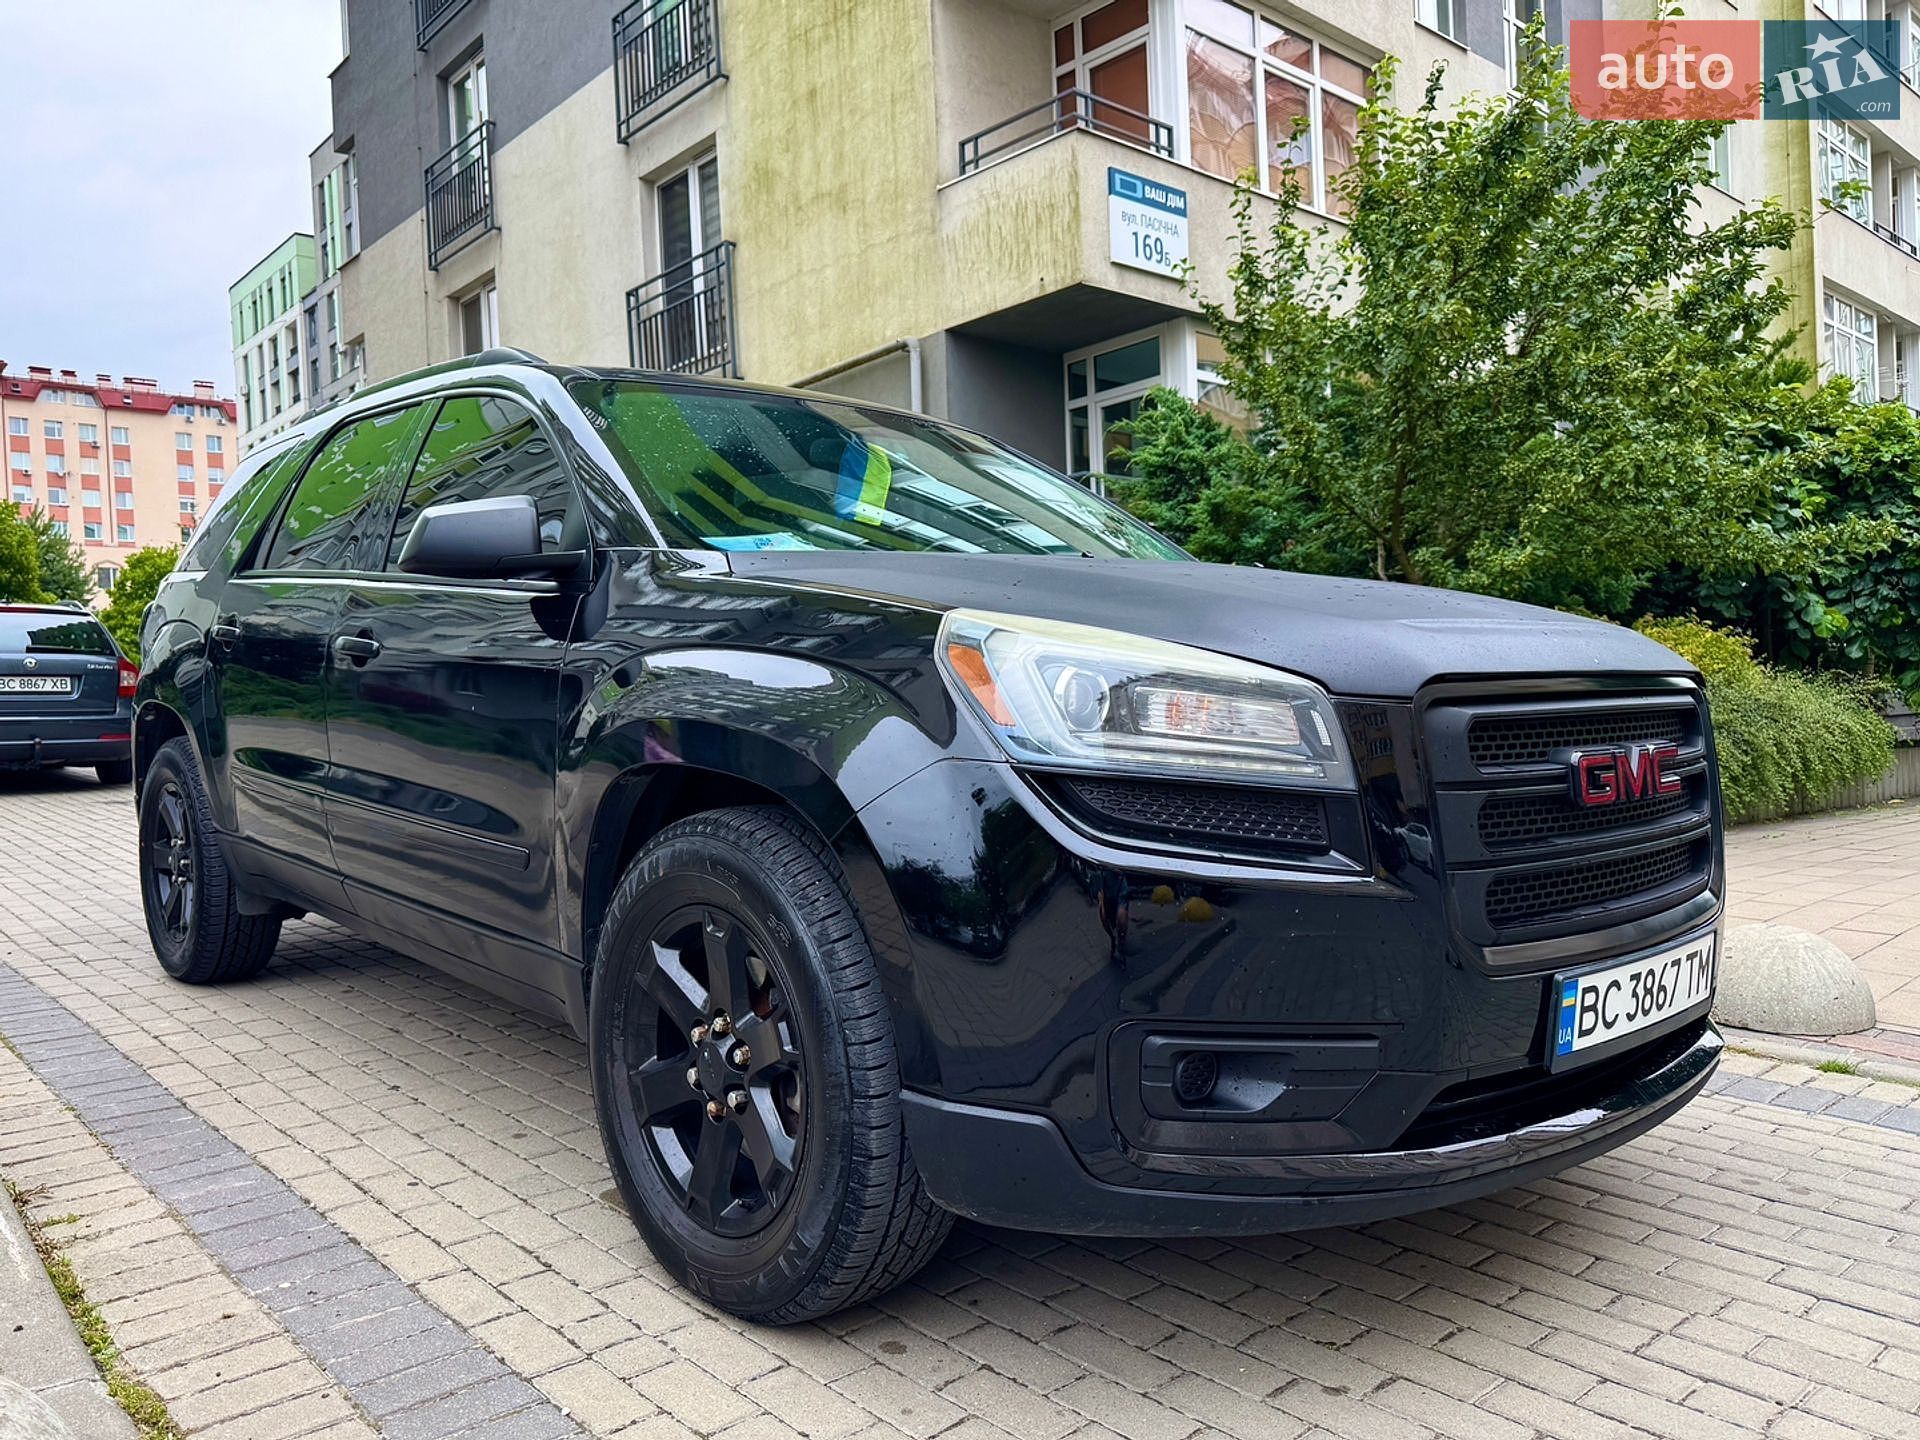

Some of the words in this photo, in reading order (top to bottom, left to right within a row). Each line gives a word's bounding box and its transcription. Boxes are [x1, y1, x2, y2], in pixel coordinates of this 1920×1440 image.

[1144, 184, 1167, 203] ВАШ
[1140, 213, 1180, 239] ПАСІЧНА
[18, 678, 47, 690] 8867
[1576, 745, 1681, 805] GMC
[1577, 978, 1623, 1039] BC
[1625, 957, 1682, 1022] 3867
[1686, 943, 1712, 1000] TM
[1558, 1028, 1573, 1045] UA
